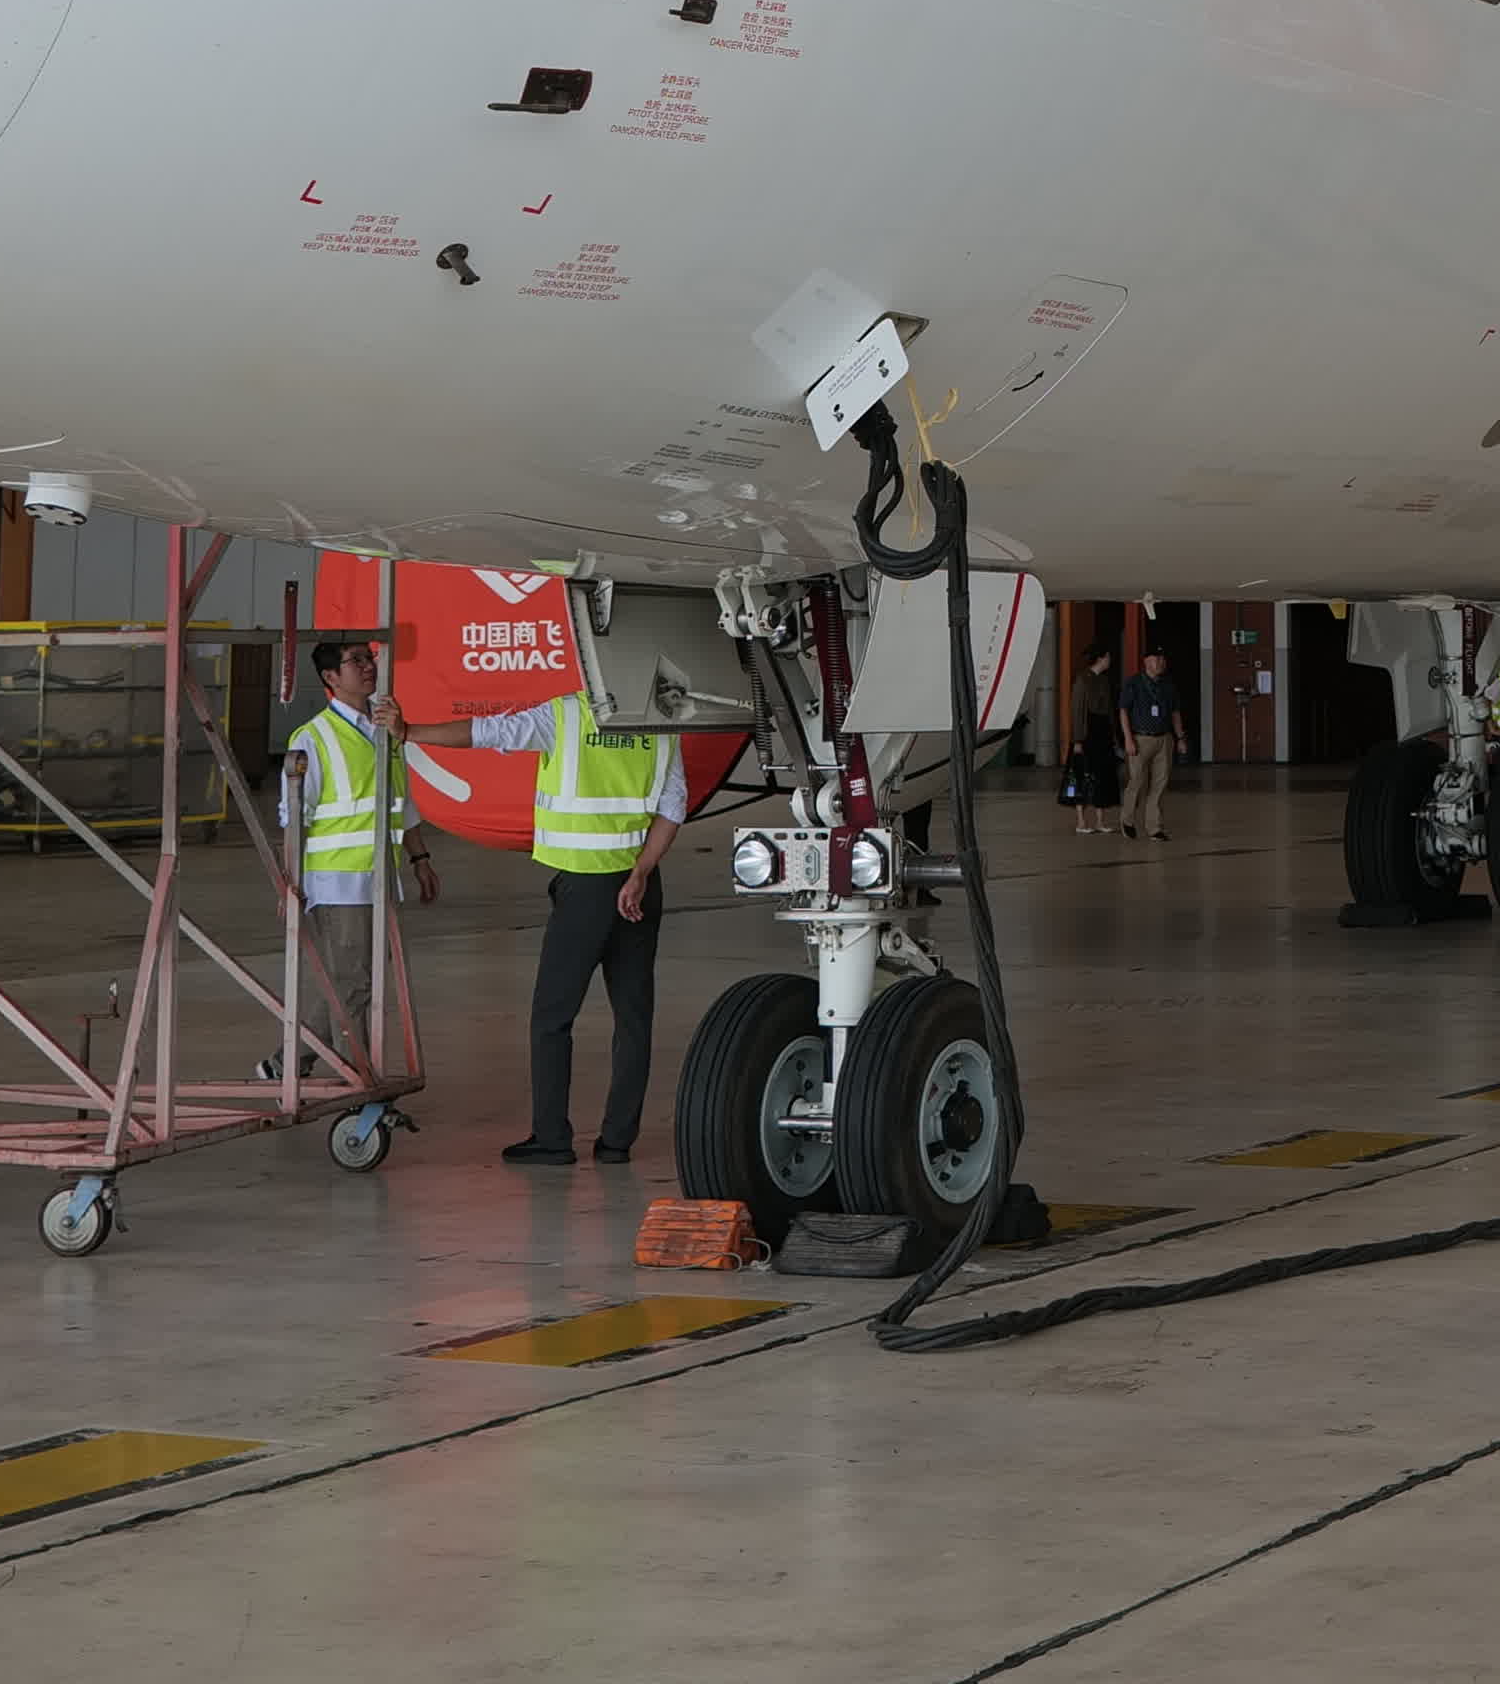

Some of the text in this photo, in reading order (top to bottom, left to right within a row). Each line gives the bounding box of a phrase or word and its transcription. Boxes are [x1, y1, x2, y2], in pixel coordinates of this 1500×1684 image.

[740, 23, 788, 38] PITOT PROBE
[744, 34, 778, 45] NO STEP
[710, 37, 801, 58] DANGER HEATED PROBE
[646, 120, 682, 131] NO STEP
[683, 115, 709, 126] PROBE
[610, 124, 708, 142] DANGER HEATED PROBE
[462, 620, 565, 649] 中国商飞
[462, 650, 566, 672] COMAC
[586, 732, 652, 750] 中国商飞
